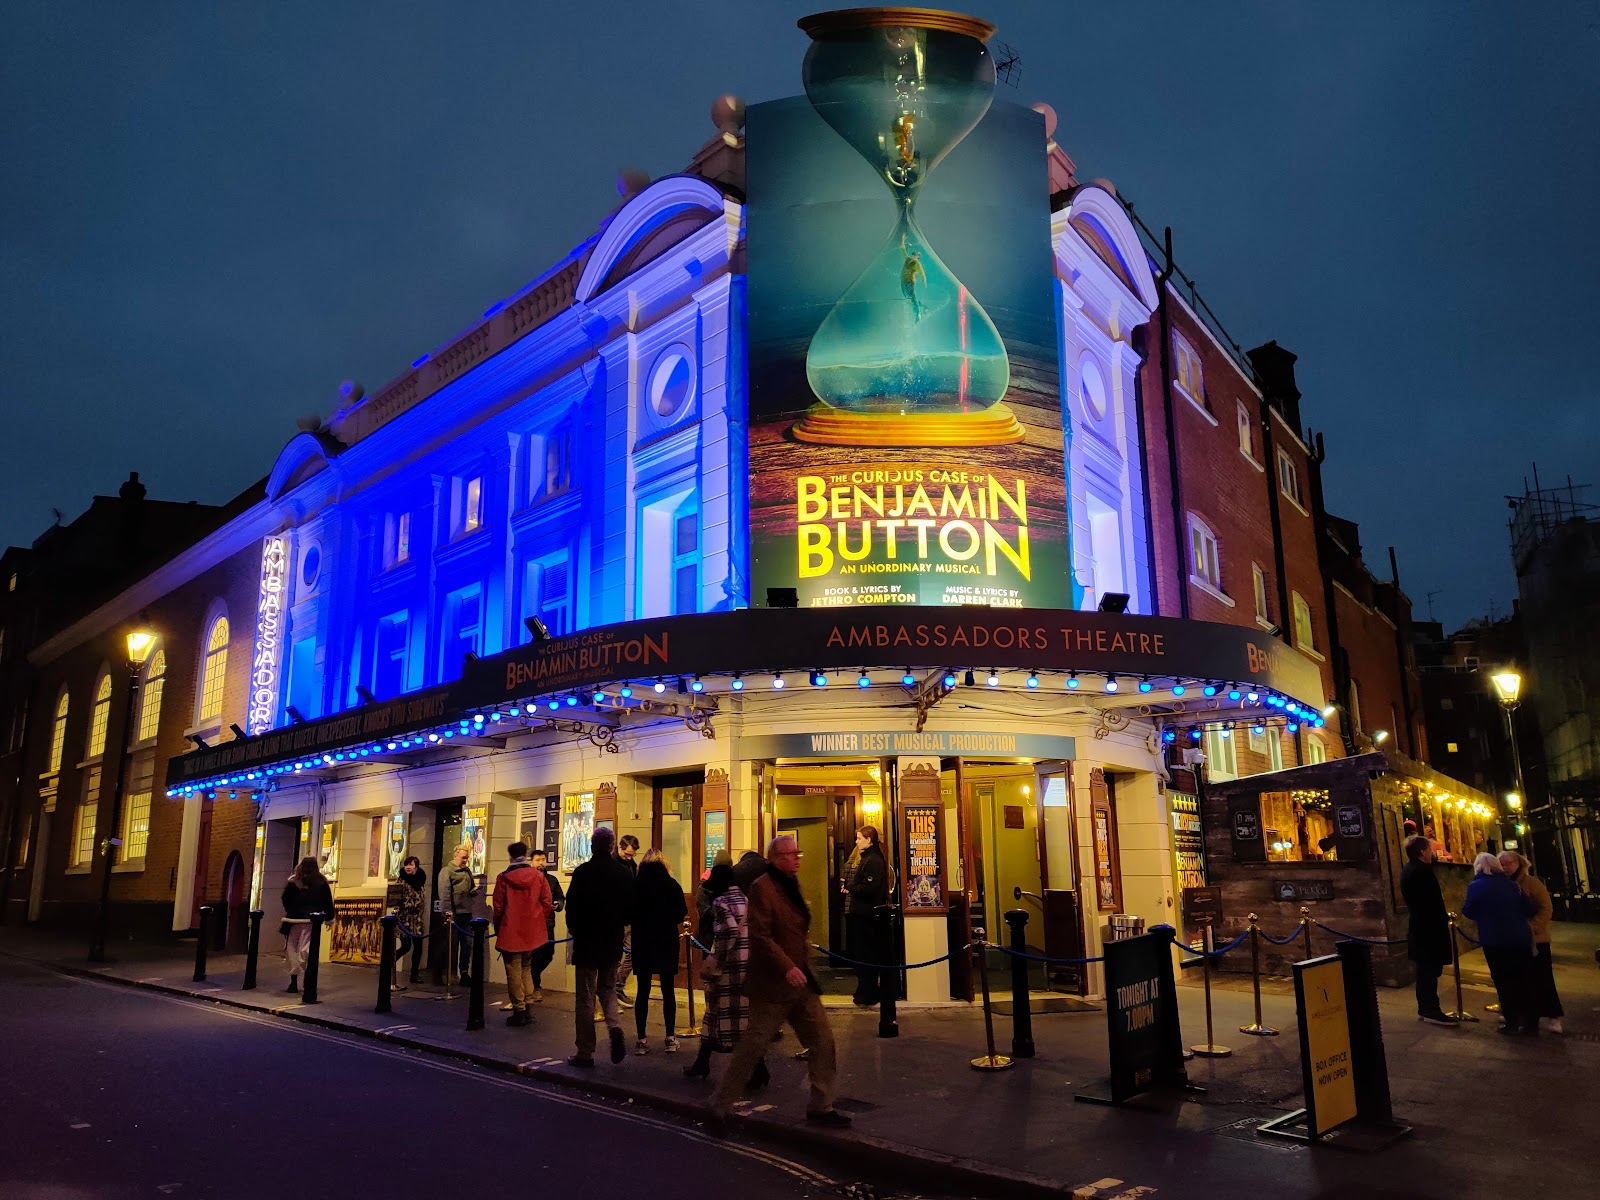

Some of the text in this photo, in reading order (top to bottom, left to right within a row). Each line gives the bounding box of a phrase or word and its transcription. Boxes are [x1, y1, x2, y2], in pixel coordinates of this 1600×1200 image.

[830, 474, 848, 484] THE
[929, 470, 968, 484] CASE
[972, 474, 985, 483] OF
[797, 472, 1028, 526] BENJAMIN
[798, 519, 1031, 581] BUTTON
[840, 563, 981, 574] AN UNORDINARY MUSICAL
[811, 594, 916, 606] JETHRO COMPTON
[824, 585, 902, 596] BOOK & LYRICS BY
[946, 586, 1018, 598] MUSIC & LYRICS BY
[942, 594, 1023, 608] DARREN CLARK
[582, 632, 604, 646] CASE
[606, 632, 614, 640] OF
[826, 624, 1165, 656] AMBASSADORS THEATRE
[506, 631, 668, 690] BENJAMIN BUTTON
[812, 733, 1016, 752] WINNER BEST MUSICAL PRODUCTION
[566, 794, 581, 814] EPIC
[910, 857, 937, 866] THEATRE
[1176, 851, 1204, 871] BENJAMIN
[1116, 976, 1160, 1010] TONIGHT AT
[1125, 1002, 1155, 1032] 7.00PM
[1316, 1051, 1348, 1072] BOX OFFICE
[1318, 1067, 1348, 1086] NOW OPEN
